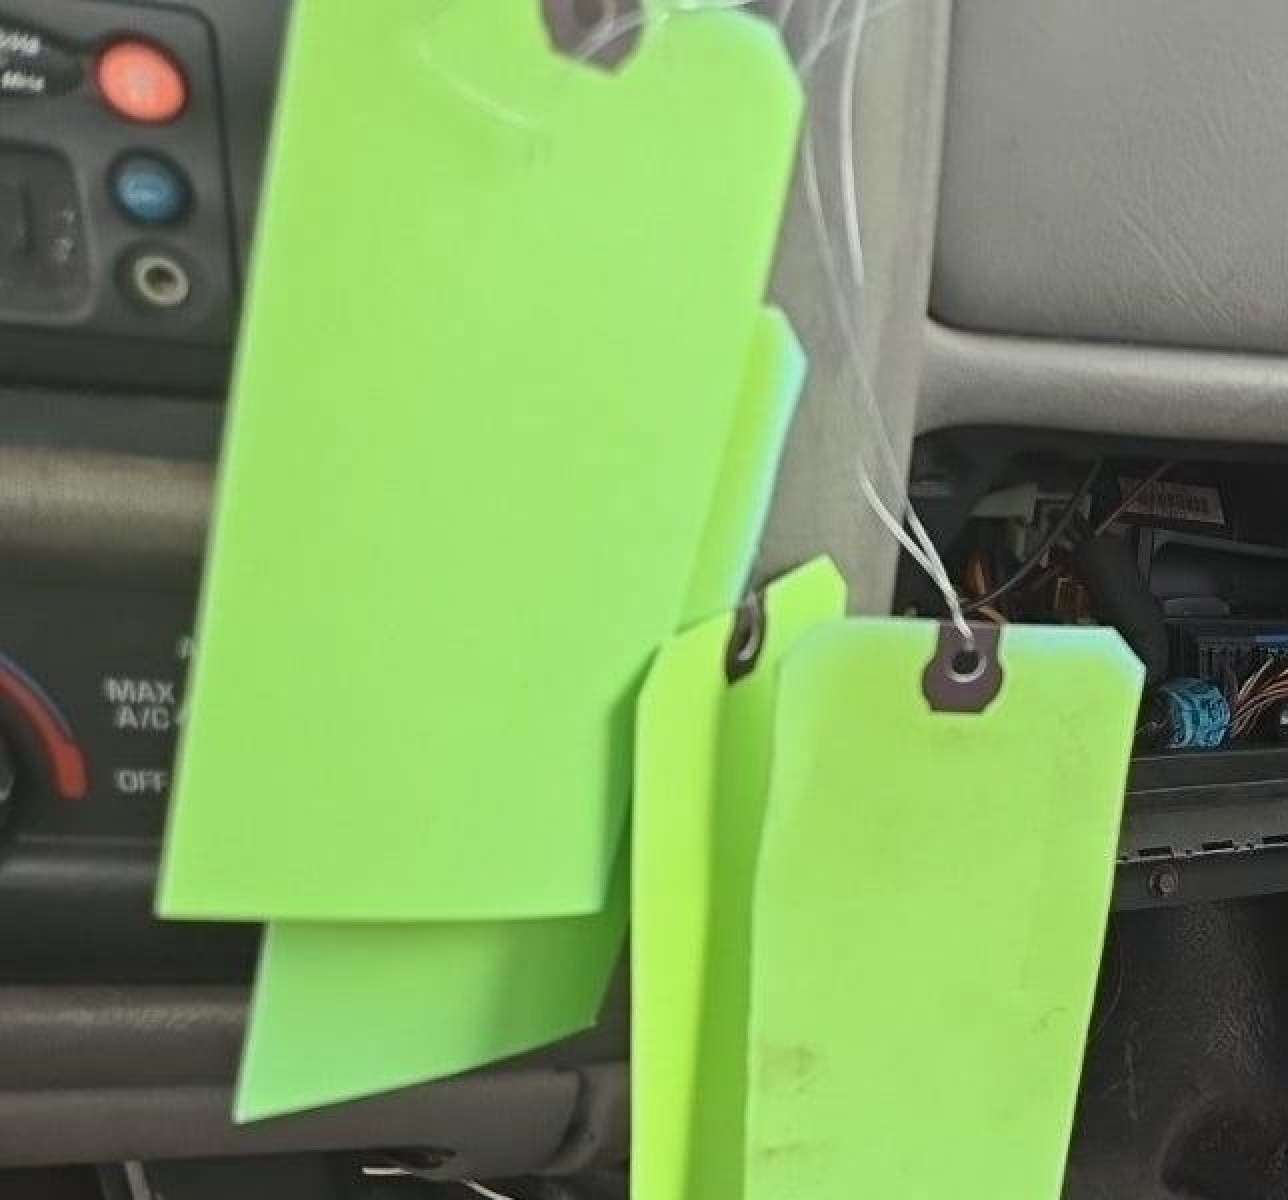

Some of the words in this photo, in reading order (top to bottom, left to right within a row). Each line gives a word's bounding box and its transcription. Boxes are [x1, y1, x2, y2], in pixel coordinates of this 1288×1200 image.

[105, 677, 174, 702] MAX
[117, 706, 170, 729] A/C
[117, 770, 167, 792] OFF
